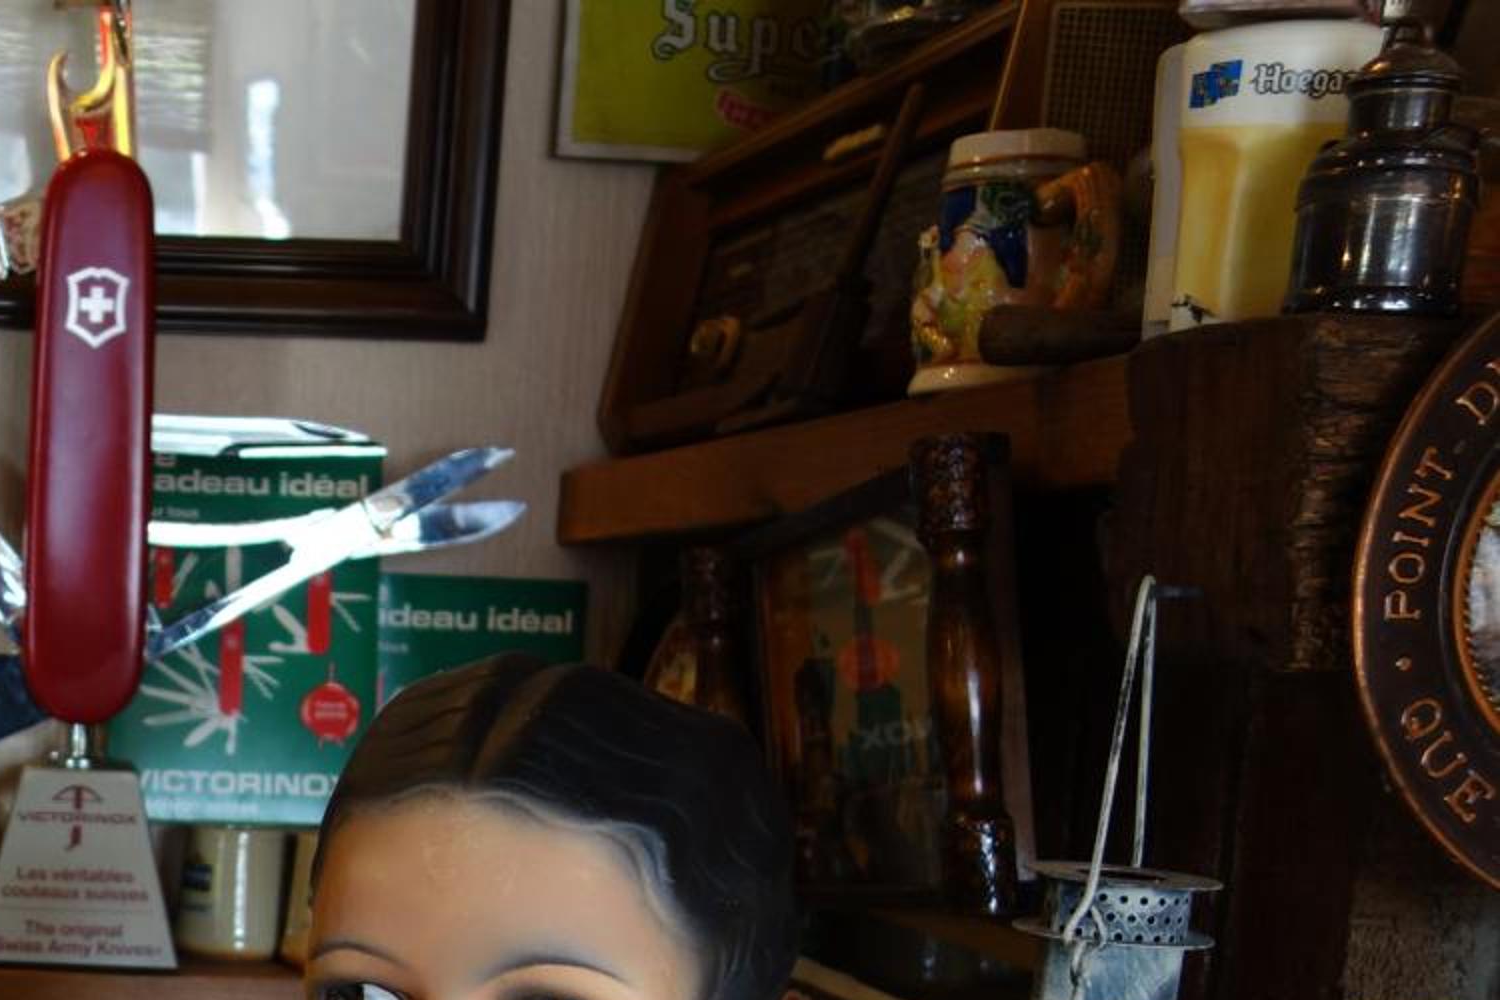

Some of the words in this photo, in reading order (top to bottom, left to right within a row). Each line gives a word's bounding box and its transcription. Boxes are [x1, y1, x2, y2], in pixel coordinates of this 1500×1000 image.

[1251, 62, 1357, 99] Hoega
[279, 471, 370, 500] idéal
[1384, 446, 1456, 624] POINT
[485, 605, 575, 635] idéal
[140, 768, 337, 796] VICTORINO
[16, 866, 47, 881] Les
[24, 919, 55, 935] The
